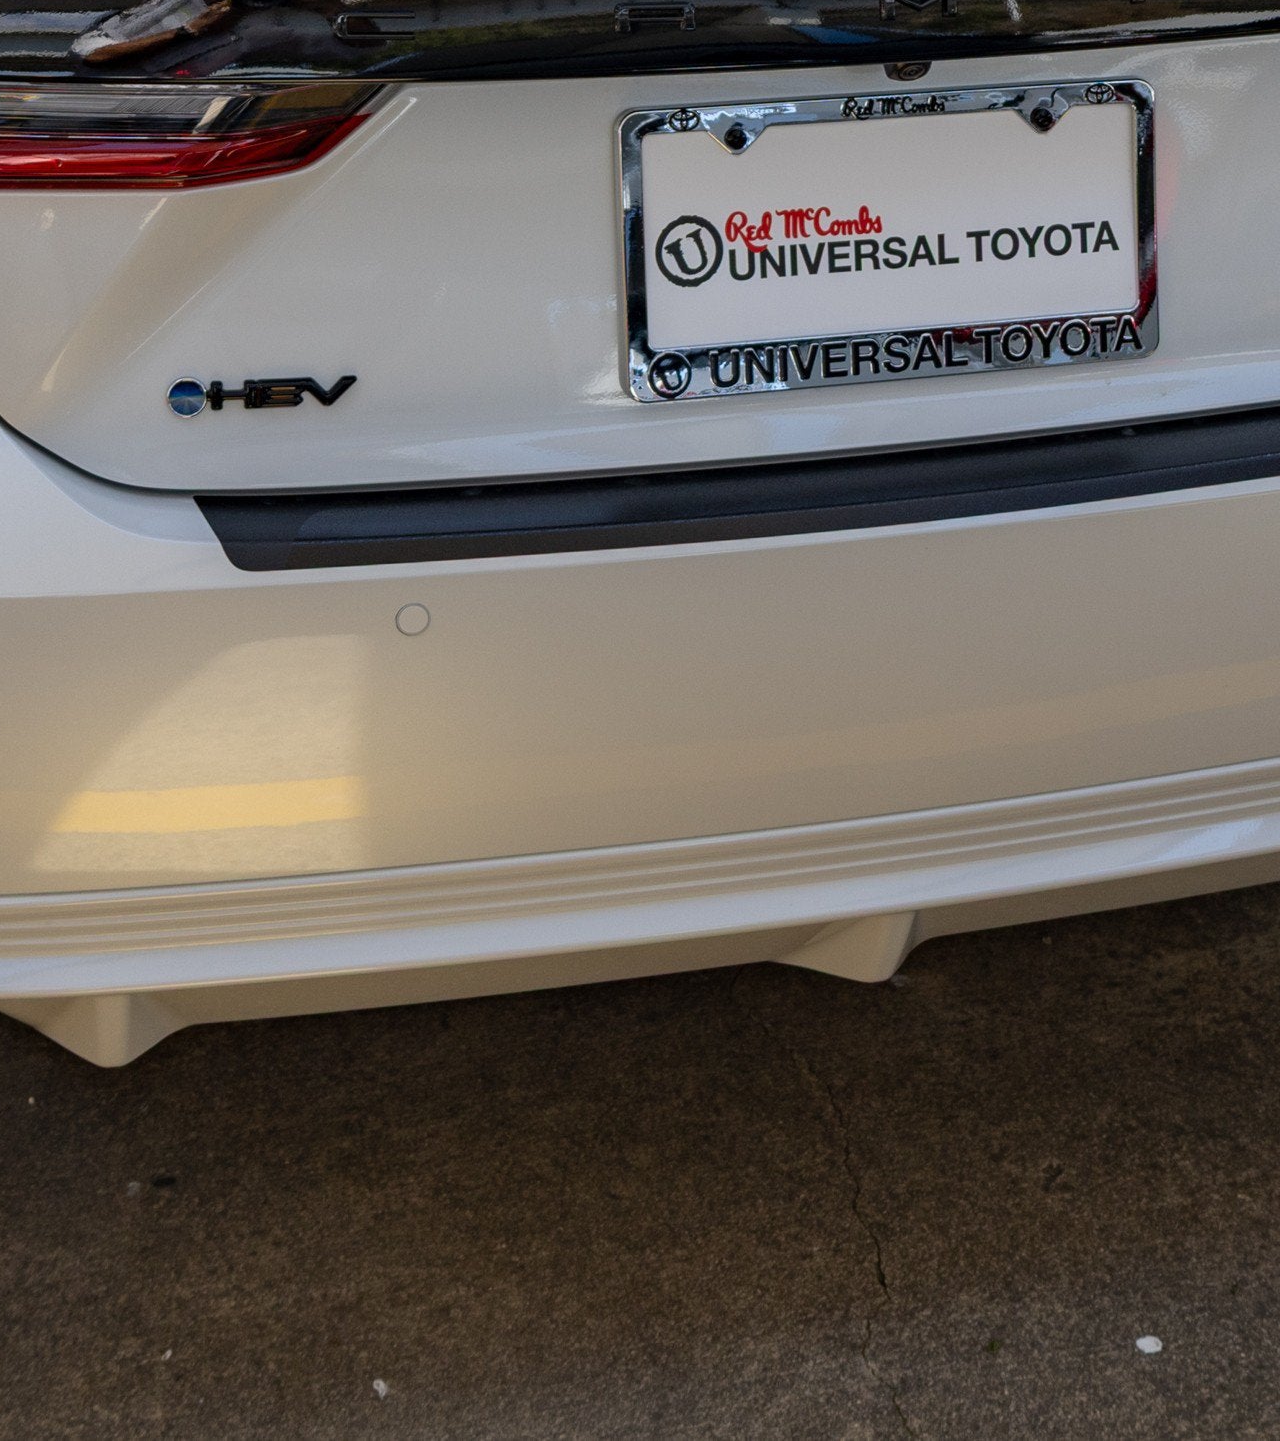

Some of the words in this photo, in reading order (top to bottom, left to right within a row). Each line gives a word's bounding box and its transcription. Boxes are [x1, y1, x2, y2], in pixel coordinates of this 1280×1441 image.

[840, 96, 874, 120] Red
[724, 211, 774, 253] Red
[775, 205, 883, 239] McCombs
[728, 233, 961, 281] UNIVERSAL
[966, 220, 1120, 262] TOYOTA
[708, 330, 969, 389] UNIVERSAL
[972, 314, 1146, 364] TOYOTA
